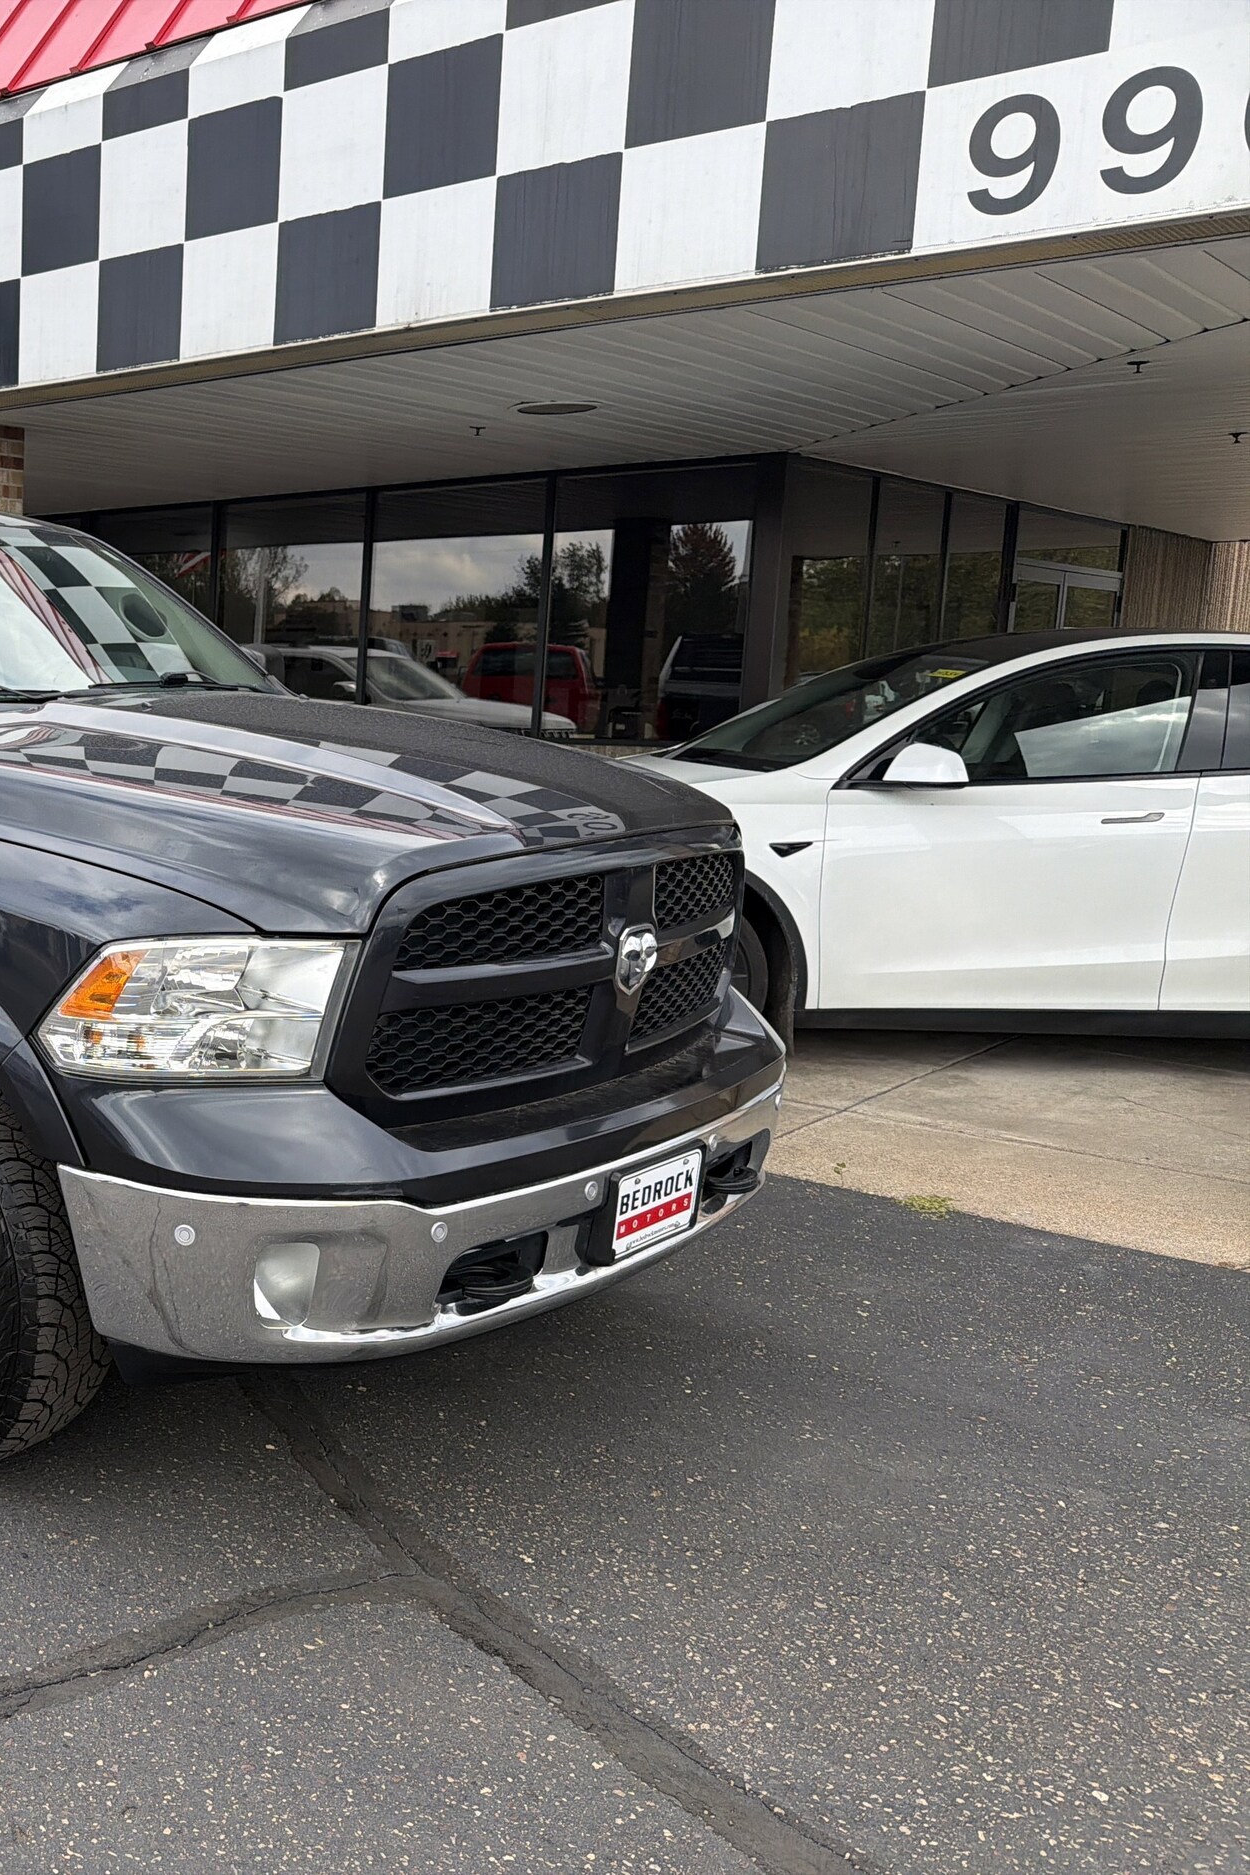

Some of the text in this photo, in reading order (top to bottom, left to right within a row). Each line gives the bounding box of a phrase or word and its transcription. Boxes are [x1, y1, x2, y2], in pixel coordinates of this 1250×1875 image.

[967, 66, 1250, 215] 99
[619, 1167, 694, 1216] BEDROCK
[620, 1198, 689, 1233] MOTORS
